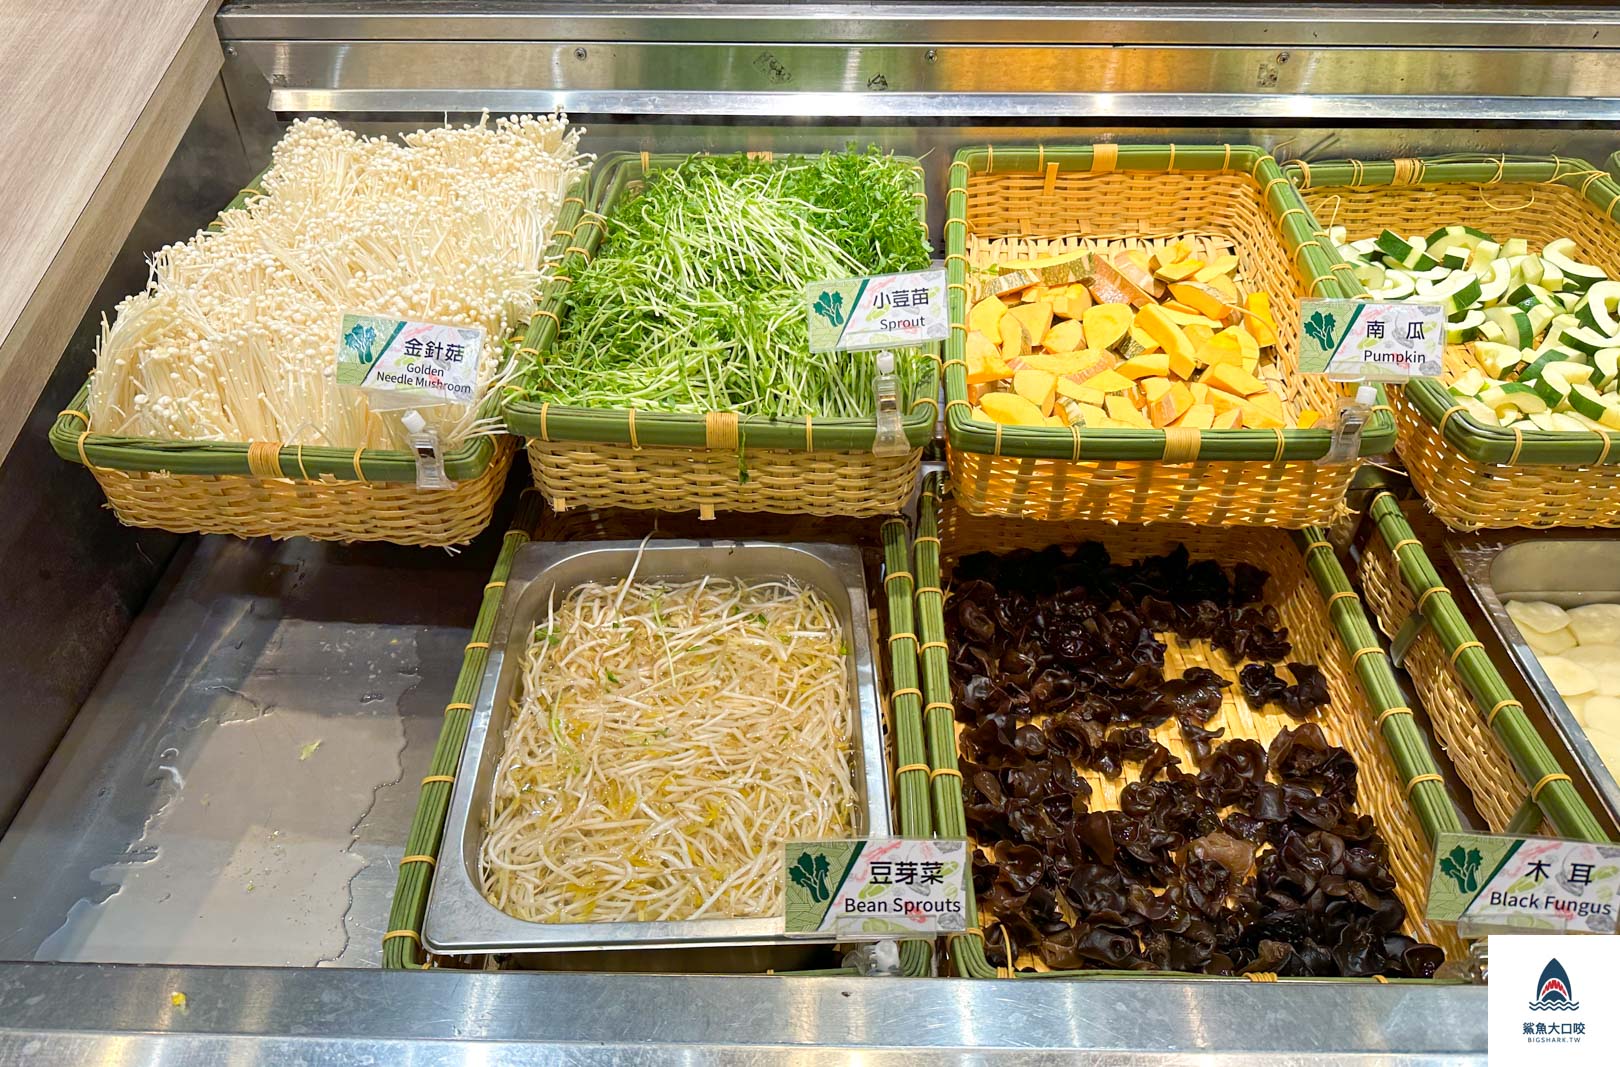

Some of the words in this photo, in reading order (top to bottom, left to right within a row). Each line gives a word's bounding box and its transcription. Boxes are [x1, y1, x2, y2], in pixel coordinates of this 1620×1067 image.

[873, 287, 929, 309] 小荳苗
[880, 316, 925, 331] Sprout
[1366, 320, 1425, 340] 南瓜
[403, 338, 465, 362] 金針菇
[1364, 350, 1426, 366] Pumpkin
[406, 363, 444, 377] Golden
[376, 371, 413, 386] Needle
[415, 377, 471, 394] Mushroom
[869, 861, 944, 885] 豆芽菜
[1524, 860, 1596, 886] 木耳
[845, 898, 887, 912] Bean
[893, 897, 961, 914] Sprouts
[1490, 891, 1540, 909] Black
[1544, 896, 1612, 917] Fungus
